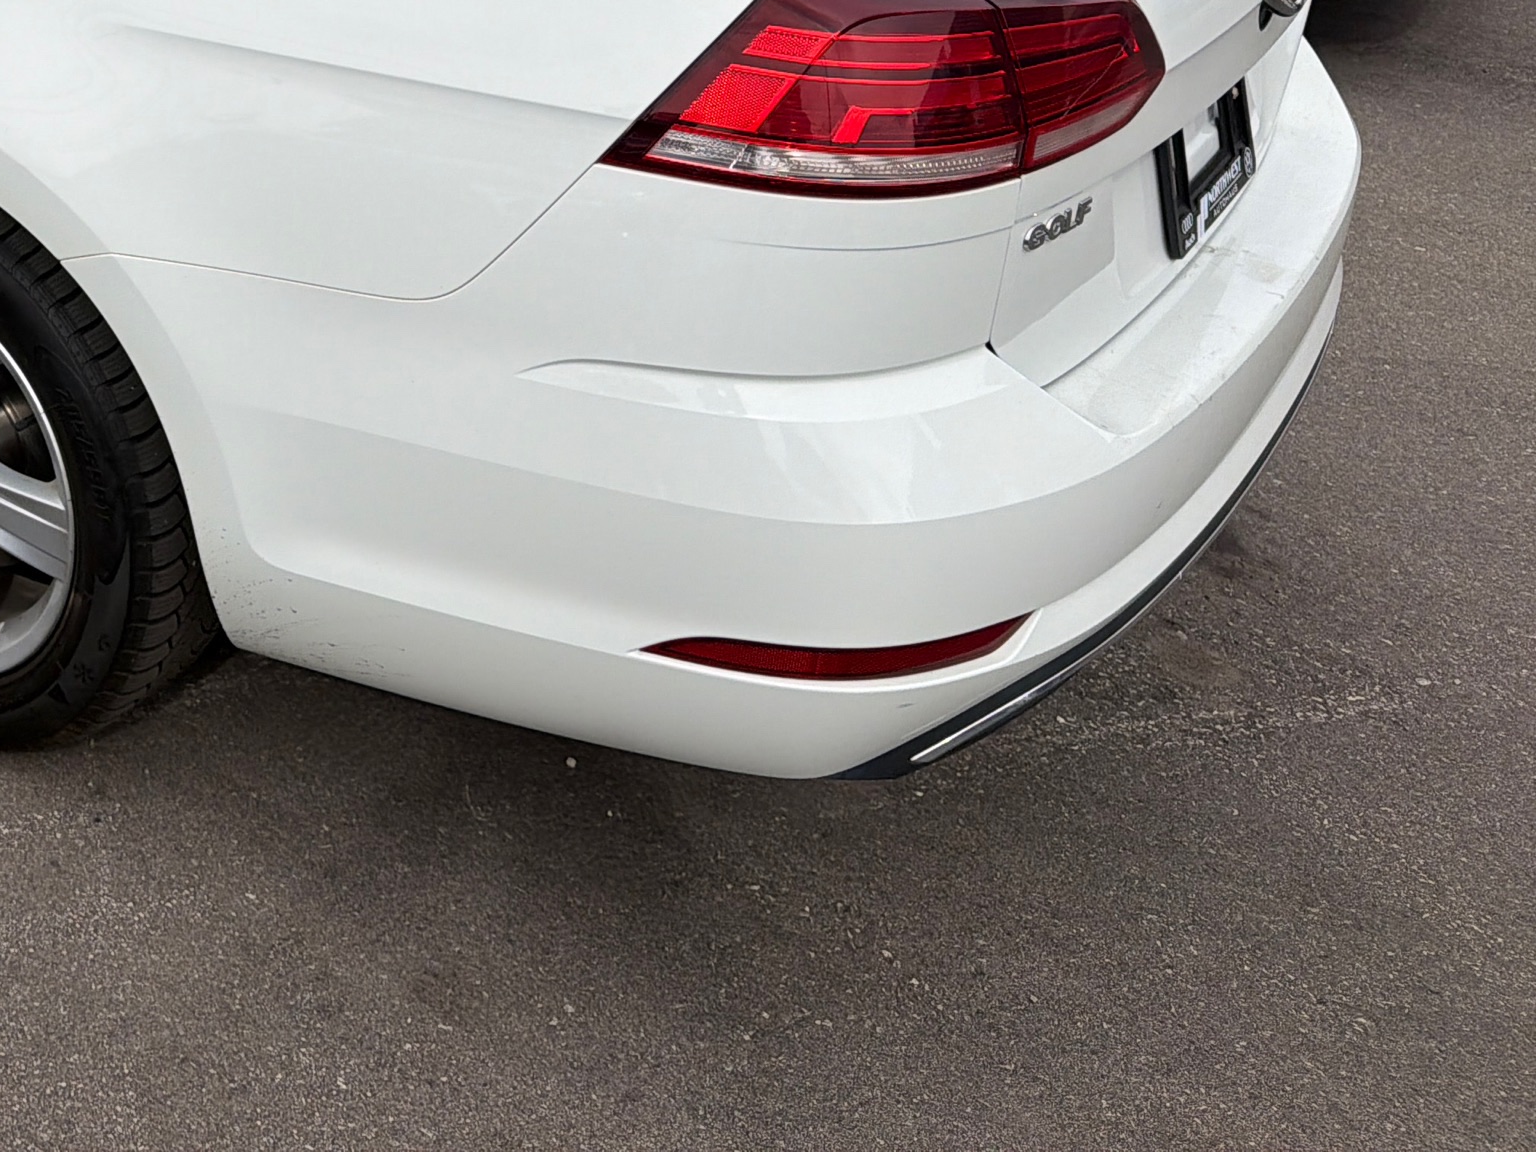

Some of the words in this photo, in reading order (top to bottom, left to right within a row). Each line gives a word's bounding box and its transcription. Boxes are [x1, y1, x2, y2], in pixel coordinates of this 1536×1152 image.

[1207, 154, 1242, 207] NORTHWEST
[1212, 183, 1239, 218] AUTOHAUS
[1023, 196, 1093, 252] GOLF
